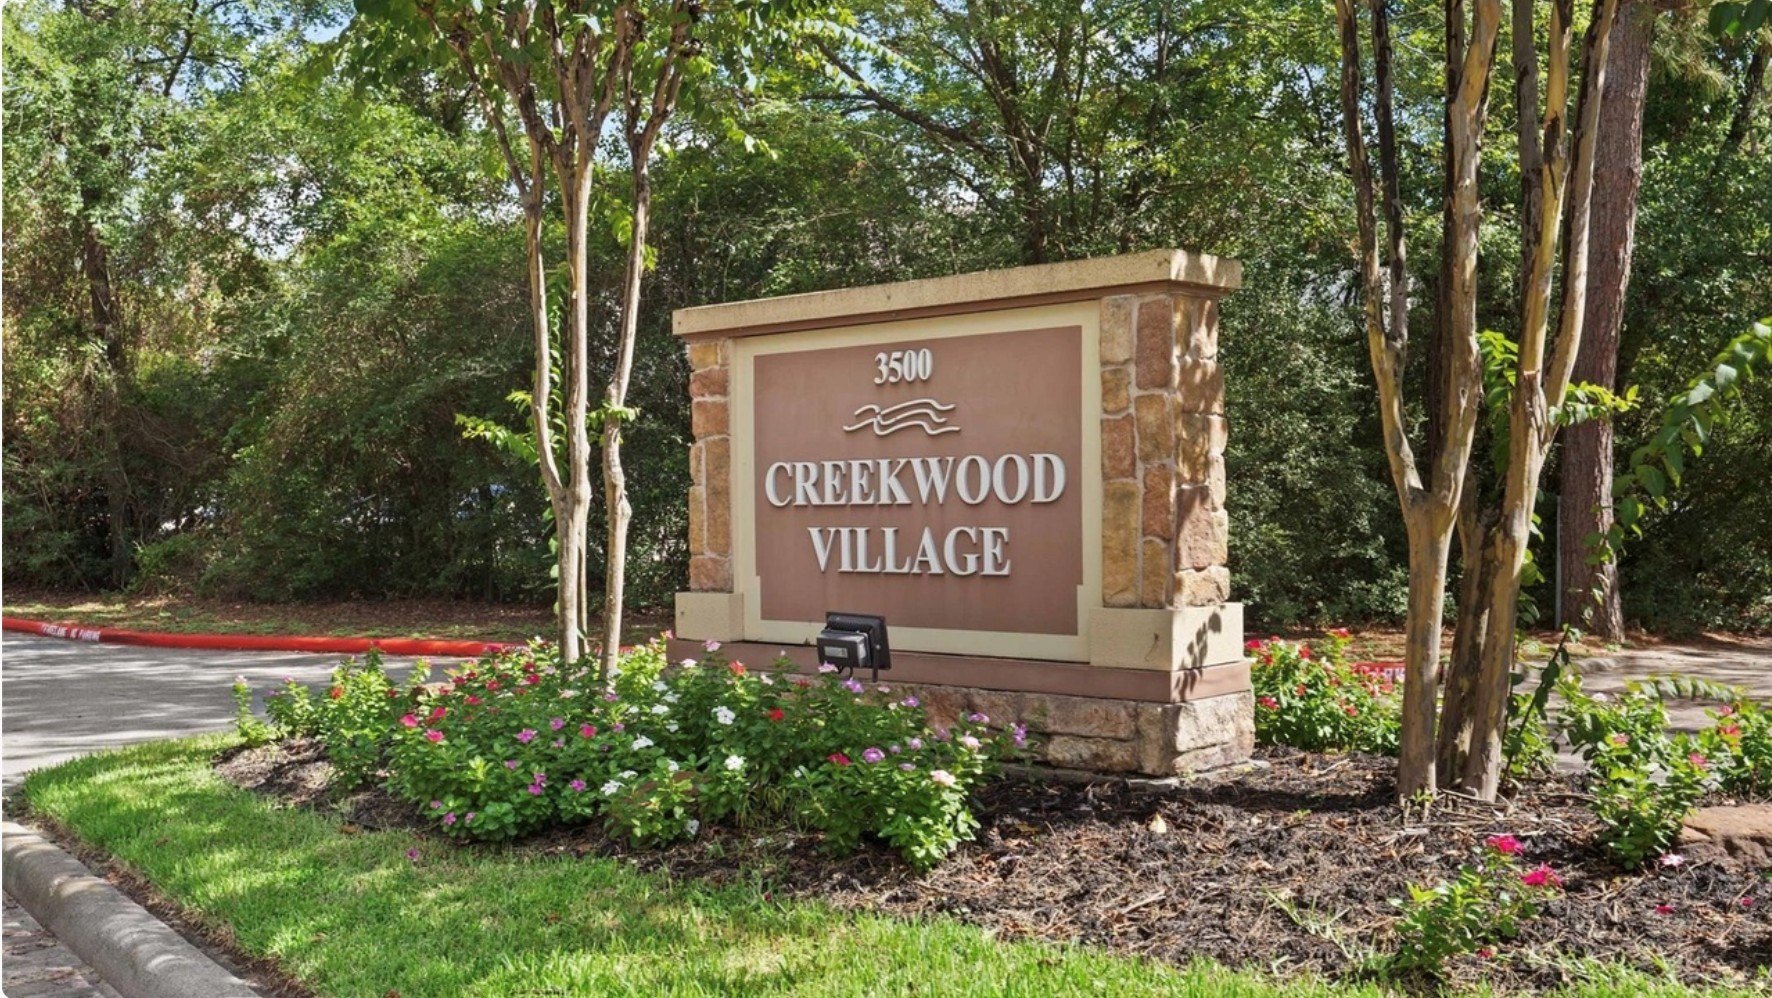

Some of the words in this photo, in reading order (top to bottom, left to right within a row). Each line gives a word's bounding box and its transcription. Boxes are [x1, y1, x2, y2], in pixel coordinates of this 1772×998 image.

[873, 348, 933, 384] 3500
[764, 453, 1066, 507] CREEKWOOD
[807, 526, 1011, 576] VILLAGE
